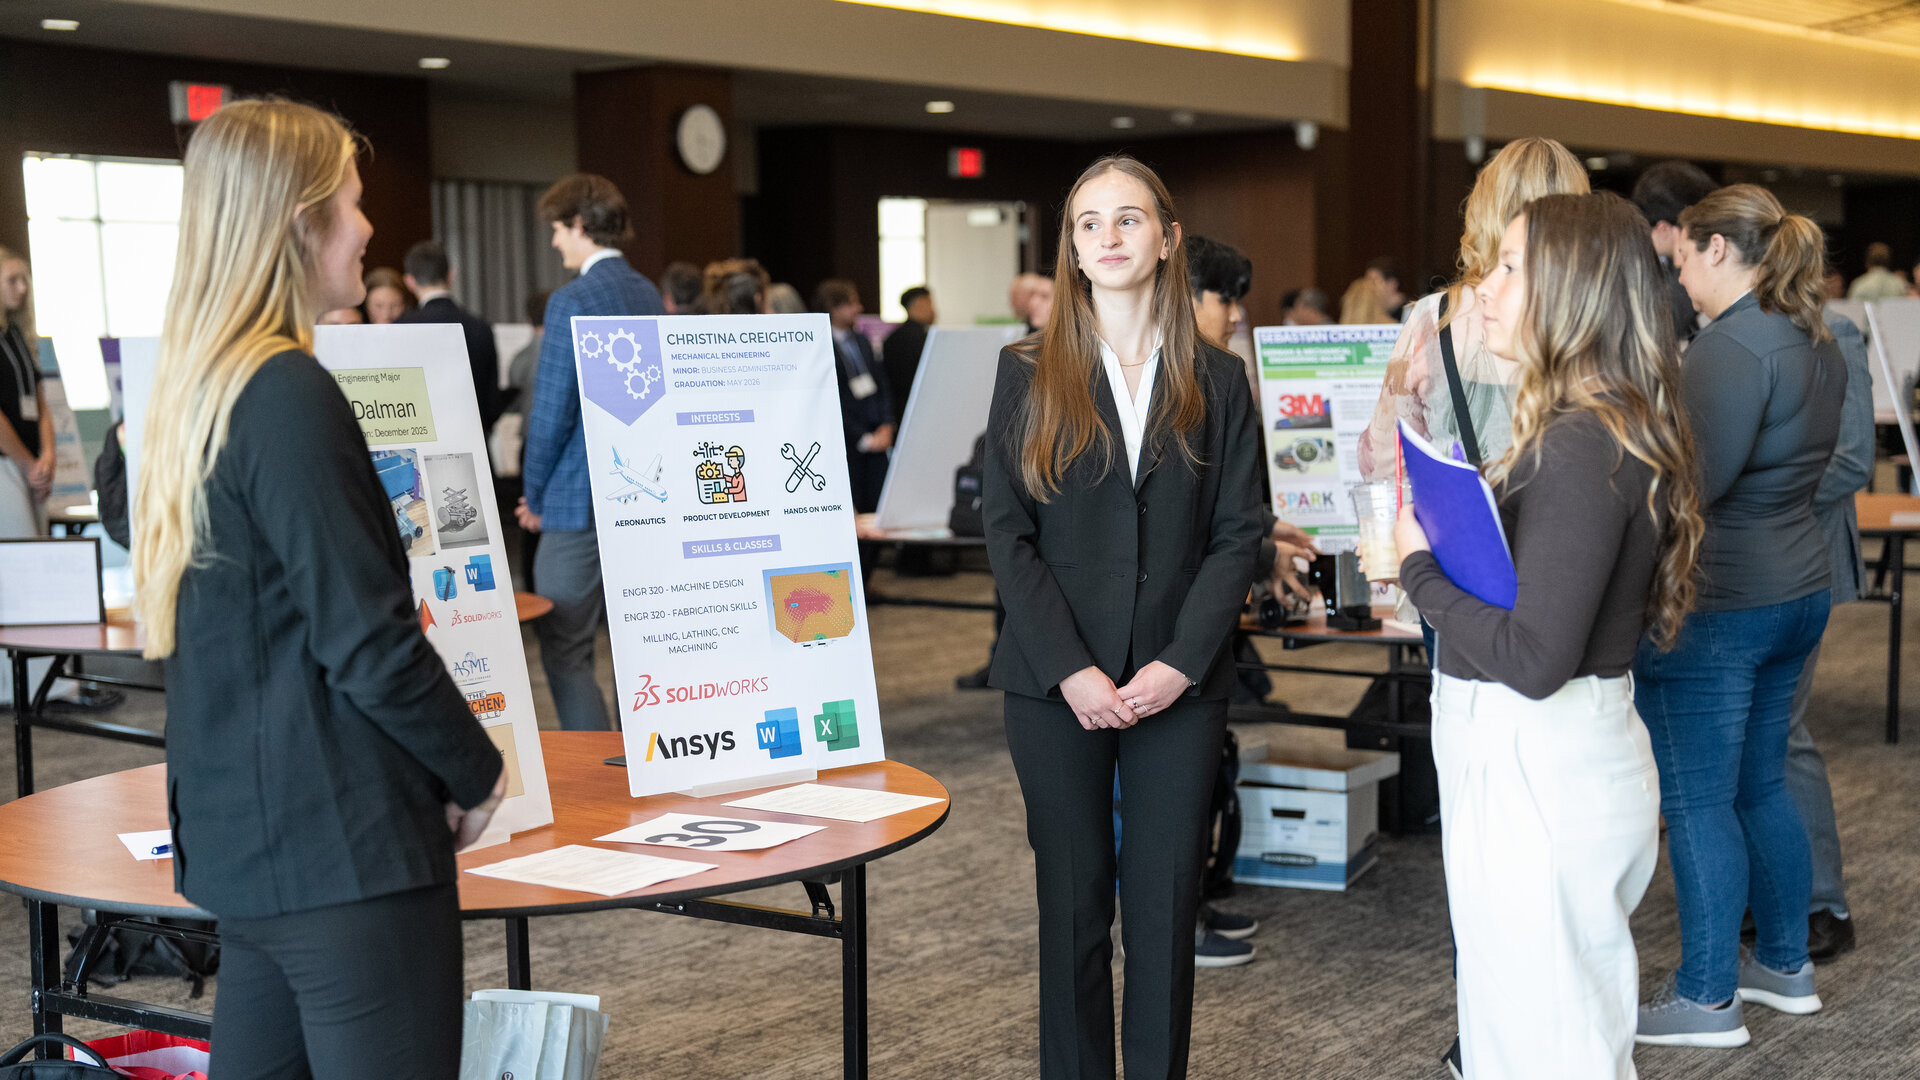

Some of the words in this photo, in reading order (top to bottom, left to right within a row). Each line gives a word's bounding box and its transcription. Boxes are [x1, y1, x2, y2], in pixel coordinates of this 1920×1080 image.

[666, 332, 737, 346] CHRISTINA
[739, 330, 815, 344] CREIGHTON
[671, 352, 720, 361] MECHANICAL
[721, 351, 771, 360] ENGINEERING
[672, 366, 700, 375] MINOR:
[701, 365, 736, 374] BUSINESS
[737, 363, 798, 373] ADMINISTRATION
[338, 374, 380, 384] Engineering
[381, 373, 401, 383] Major
[674, 380, 726, 389] GRADUATION:
[726, 379, 743, 387] MAY
[743, 378, 761, 386] 2026
[352, 400, 417, 420] Dalman
[1279, 393, 1326, 417] 3M
[691, 412, 740, 423] INTERESTS
[374, 428, 409, 438] December
[411, 426, 428, 436] 2025
[1276, 491, 1334, 509] SPARK
[683, 513, 718, 523] PRODUCT
[718, 509, 770, 521] DEVELOPMENT
[783, 506, 807, 515] HANDS
[807, 506, 819, 514] ON
[820, 504, 843, 513] WORK
[615, 517, 666, 527] AERONAUTICS
[691, 542, 722, 555] SKILLS
[724, 542, 731, 552] &
[732, 539, 773, 552] CLASSES
[467, 567, 478, 581] W
[622, 586, 648, 598] ENGR
[648, 585, 664, 596] 320
[670, 581, 711, 594] MACHINE
[712, 578, 744, 590] DESIGN
[463, 610, 503, 624] SOLIDWORKS
[624, 611, 649, 622] ENGR
[650, 610, 666, 621] 320
[672, 604, 729, 618] FABRICATION
[730, 601, 757, 613] SKILLS
[643, 632, 680, 644] MILLING,
[681, 628, 720, 641] LATHING,
[721, 625, 740, 636] CNC
[668, 641, 718, 655] MACHINING
[452, 657, 490, 677] ASME
[467, 692, 485, 700] THE
[666, 676, 769, 704] SOLIDWORKS
[468, 696, 502, 713] CHEN
[759, 726, 777, 744] W
[820, 719, 831, 736] X
[645, 730, 736, 762] Ansys
[644, 820, 762, 848] 30
